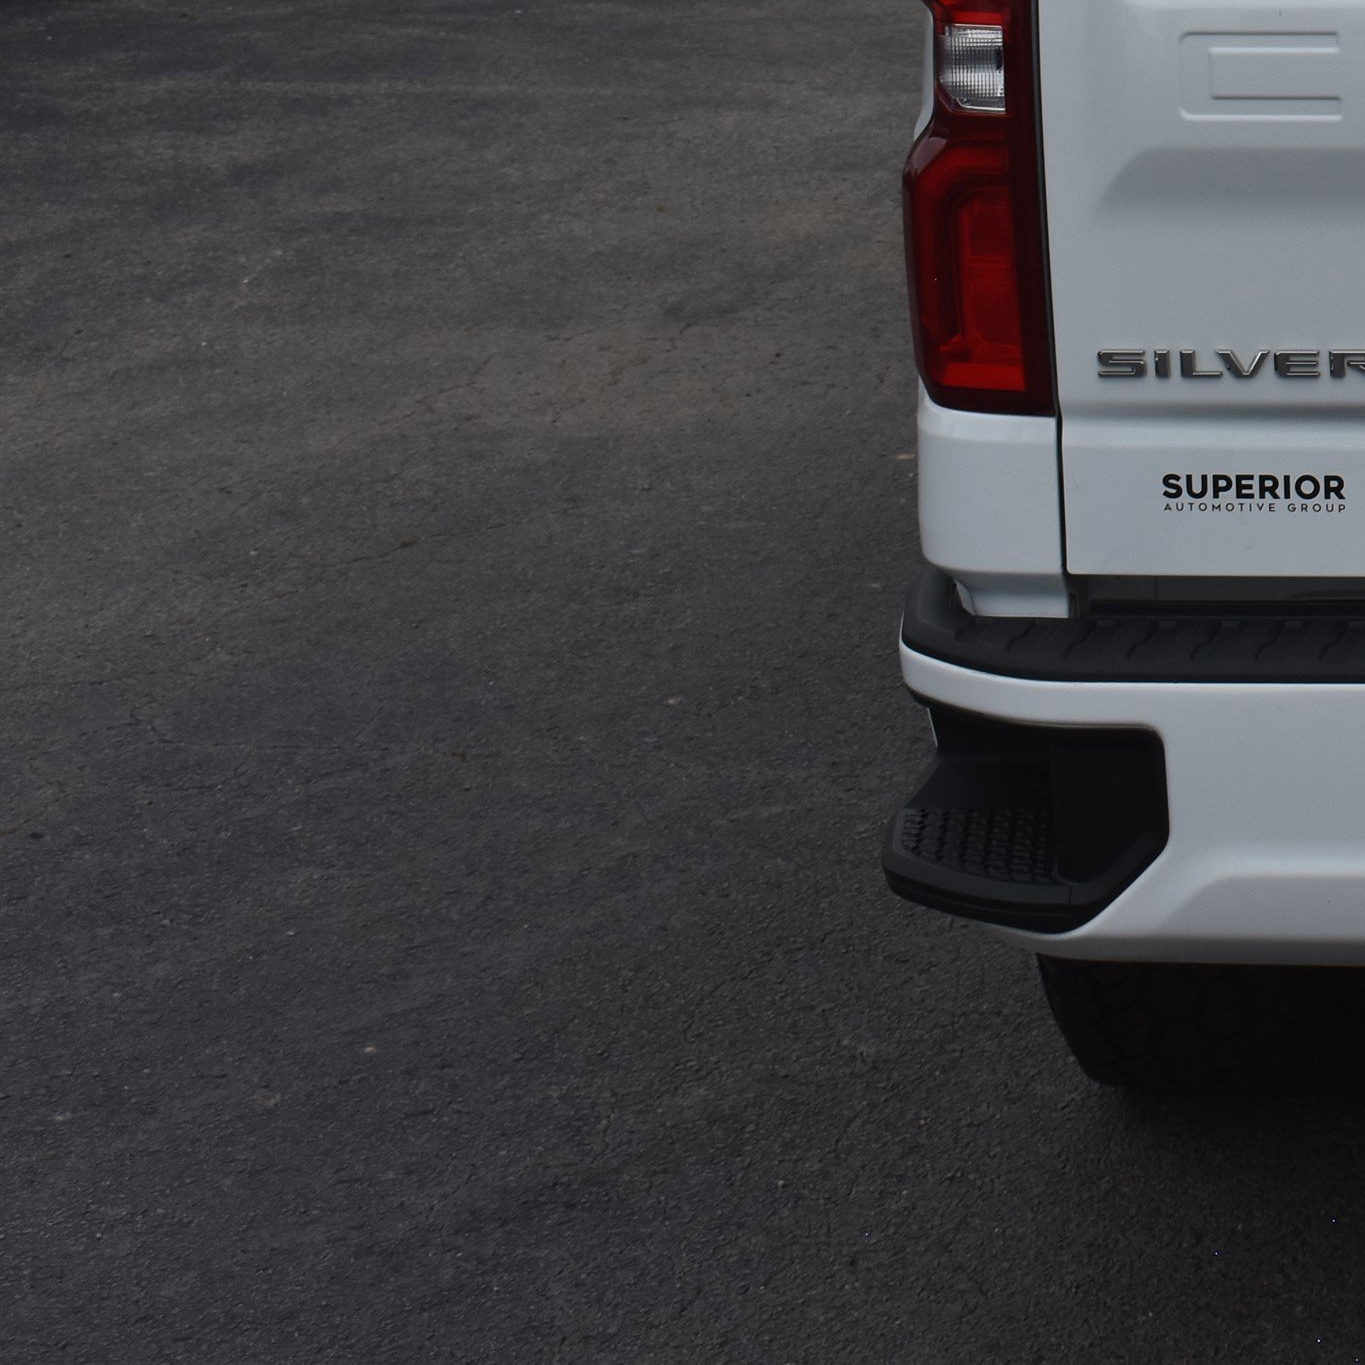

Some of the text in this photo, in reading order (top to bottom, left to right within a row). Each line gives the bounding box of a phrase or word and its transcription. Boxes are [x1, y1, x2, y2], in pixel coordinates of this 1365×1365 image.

[1162, 473, 1346, 500] SUPERIOR
[1164, 502, 1346, 513] AUTOMOTIVE GROUP
